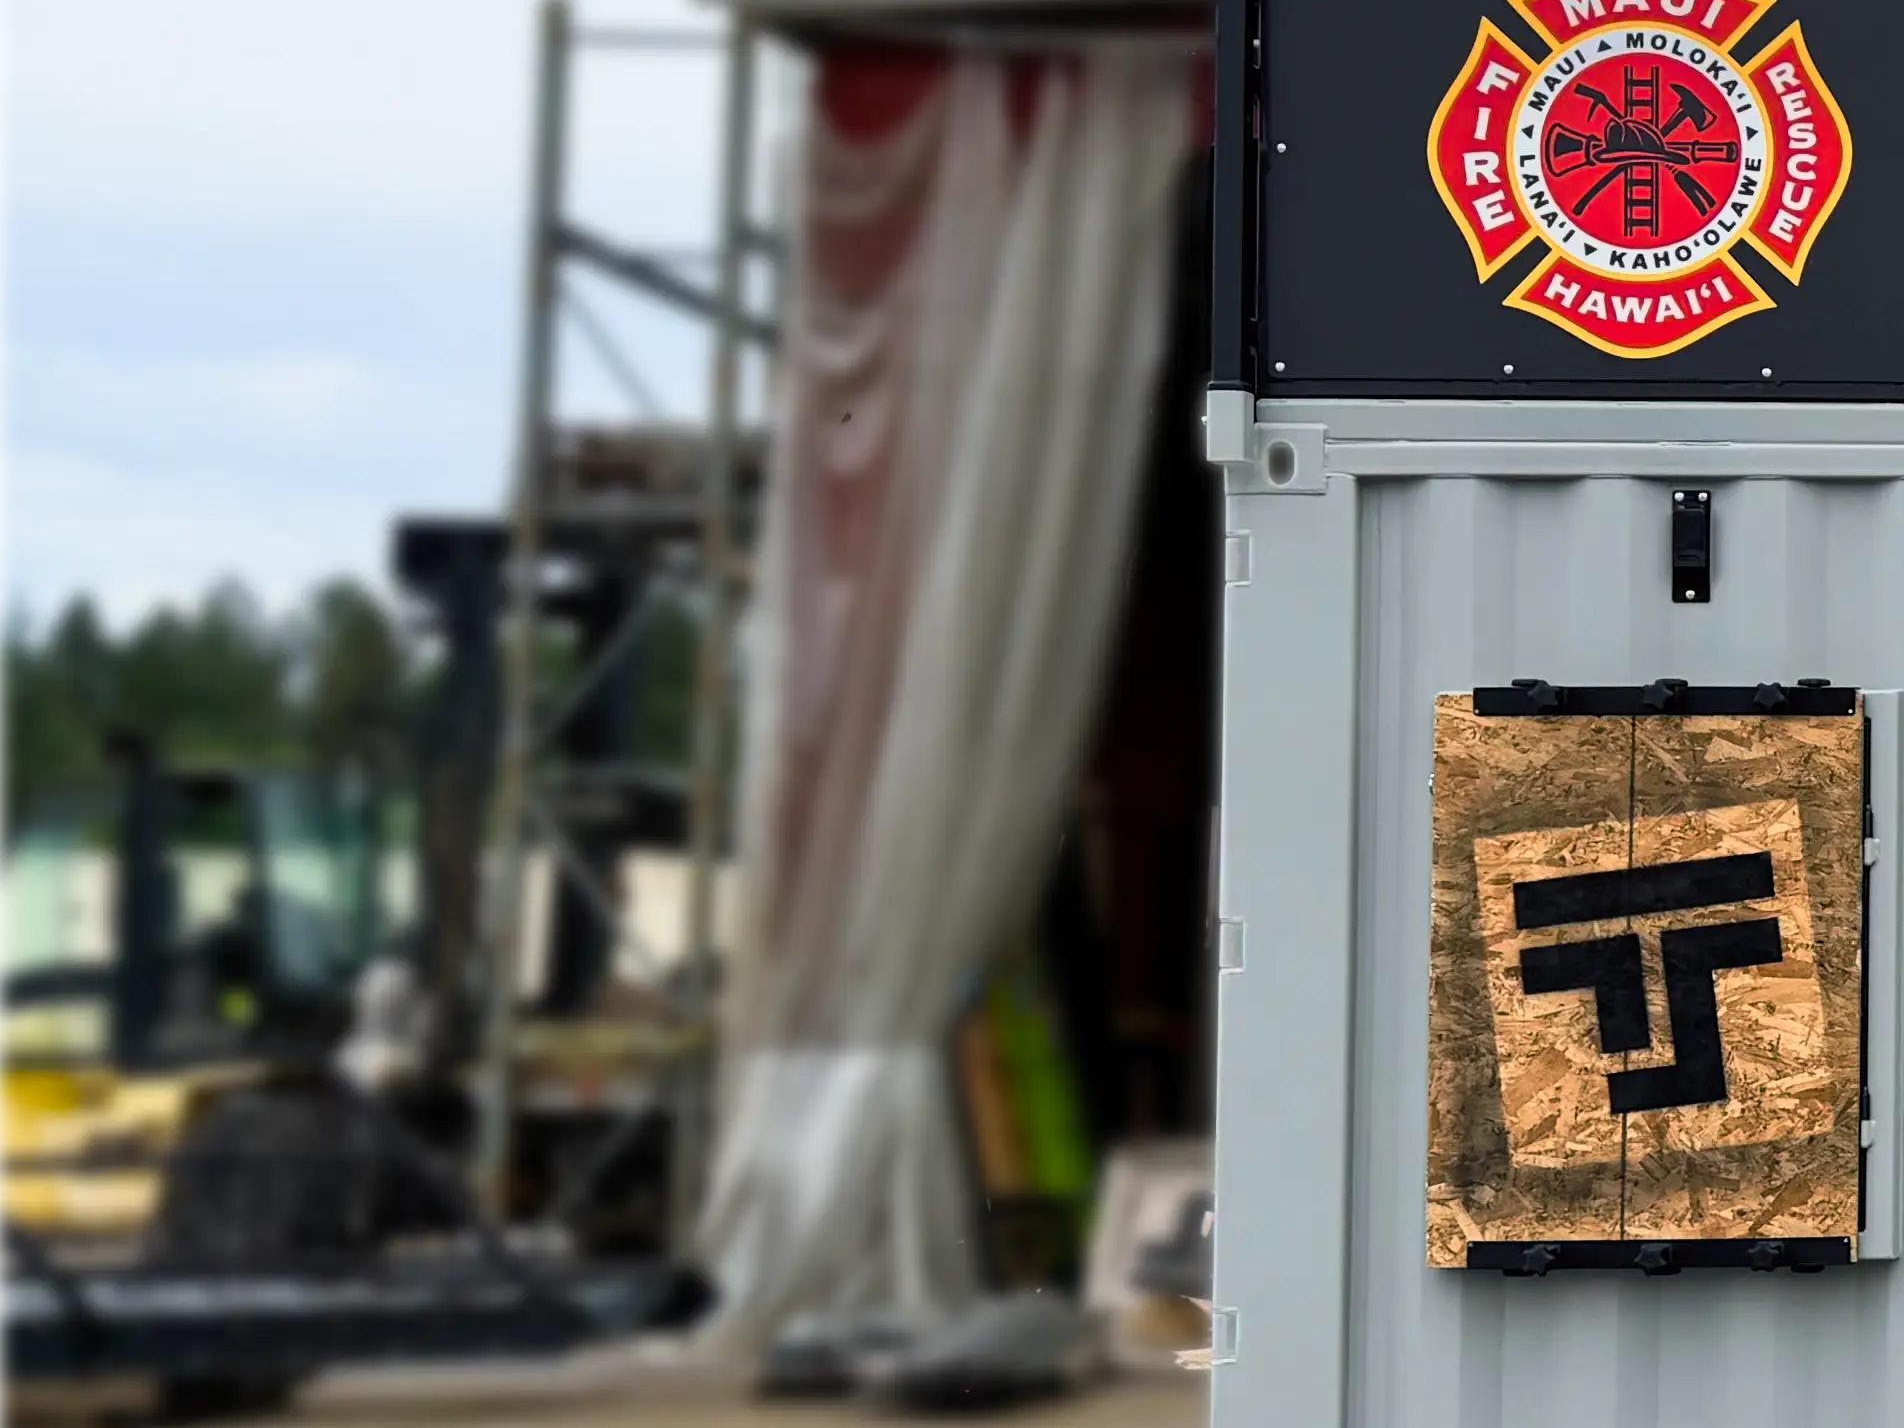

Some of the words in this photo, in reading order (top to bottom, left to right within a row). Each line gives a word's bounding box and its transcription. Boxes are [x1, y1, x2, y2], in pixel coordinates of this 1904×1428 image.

[1462, 59, 1520, 232] FIRE
[1528, 48, 1587, 112] MAUI
[1765, 60, 1818, 244] RESCUE
